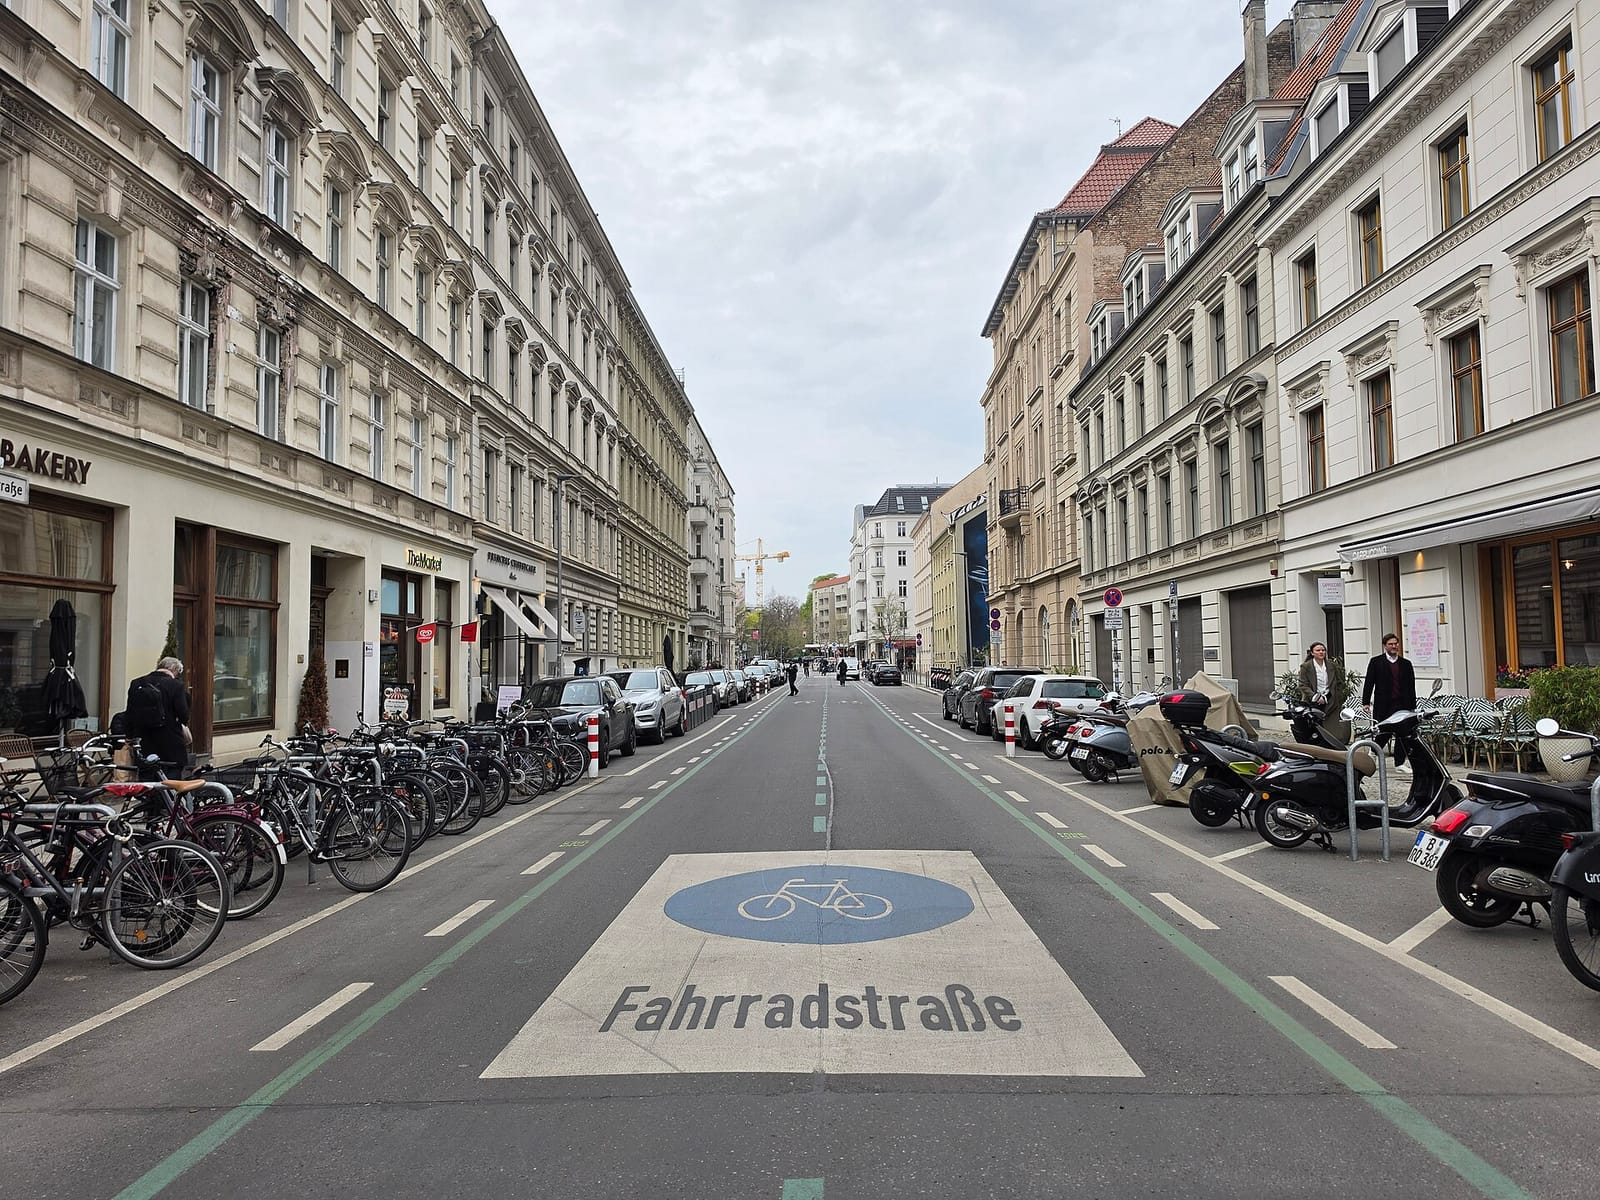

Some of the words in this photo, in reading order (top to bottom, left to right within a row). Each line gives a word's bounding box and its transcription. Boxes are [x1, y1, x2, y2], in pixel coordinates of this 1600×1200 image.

[1, 439, 91, 485] BAKERY
[0, 481, 23, 497] raße
[1426, 838, 1436, 851] B
[598, 983, 1022, 1032] Fahrradstraße
